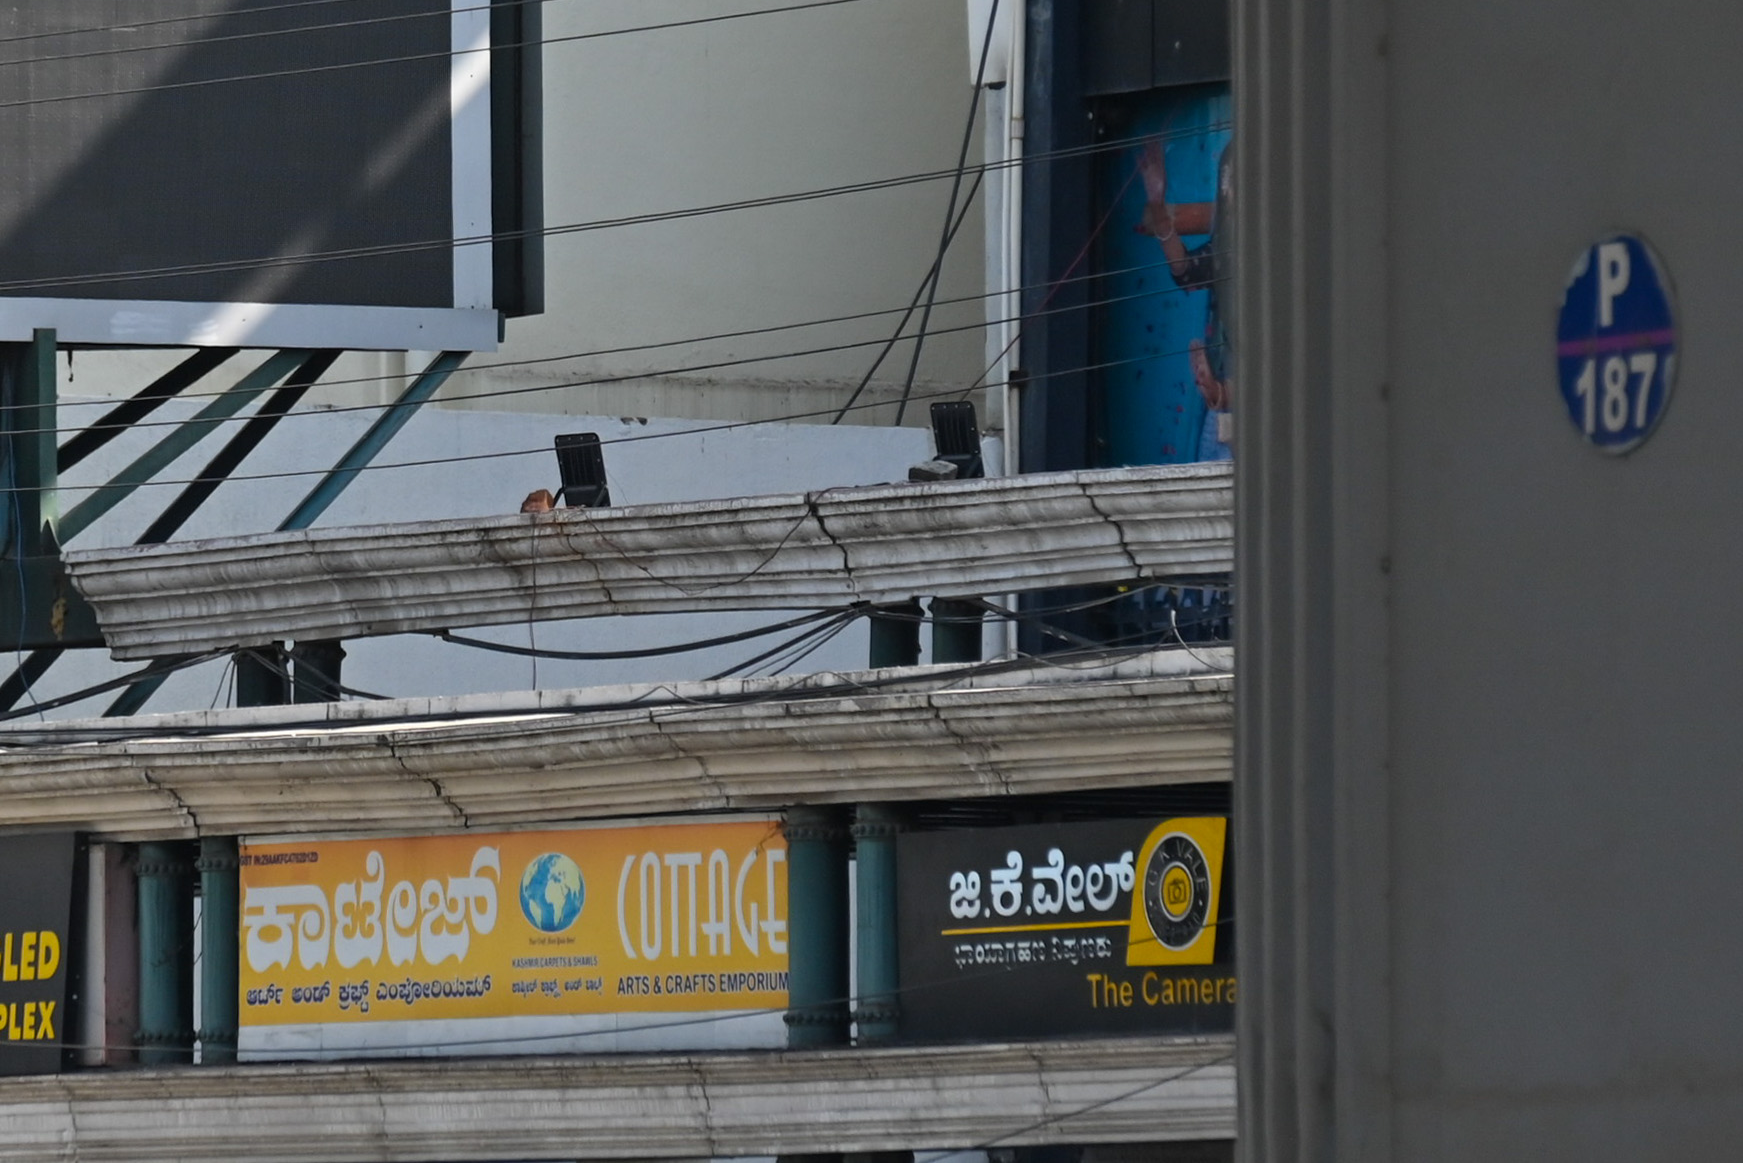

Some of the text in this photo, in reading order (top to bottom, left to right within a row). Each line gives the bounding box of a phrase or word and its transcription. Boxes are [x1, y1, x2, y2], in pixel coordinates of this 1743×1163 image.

[1598, 243, 1631, 328] P
[1575, 353, 1658, 436] 187
[242, 844, 502, 973] ಕಾಟೇಜ್
[616, 846, 790, 963] COTTAGE
[617, 971, 790, 996] ARTS & CRAFTS EMPORIUM
[1086, 970, 1237, 1008] The Camera
